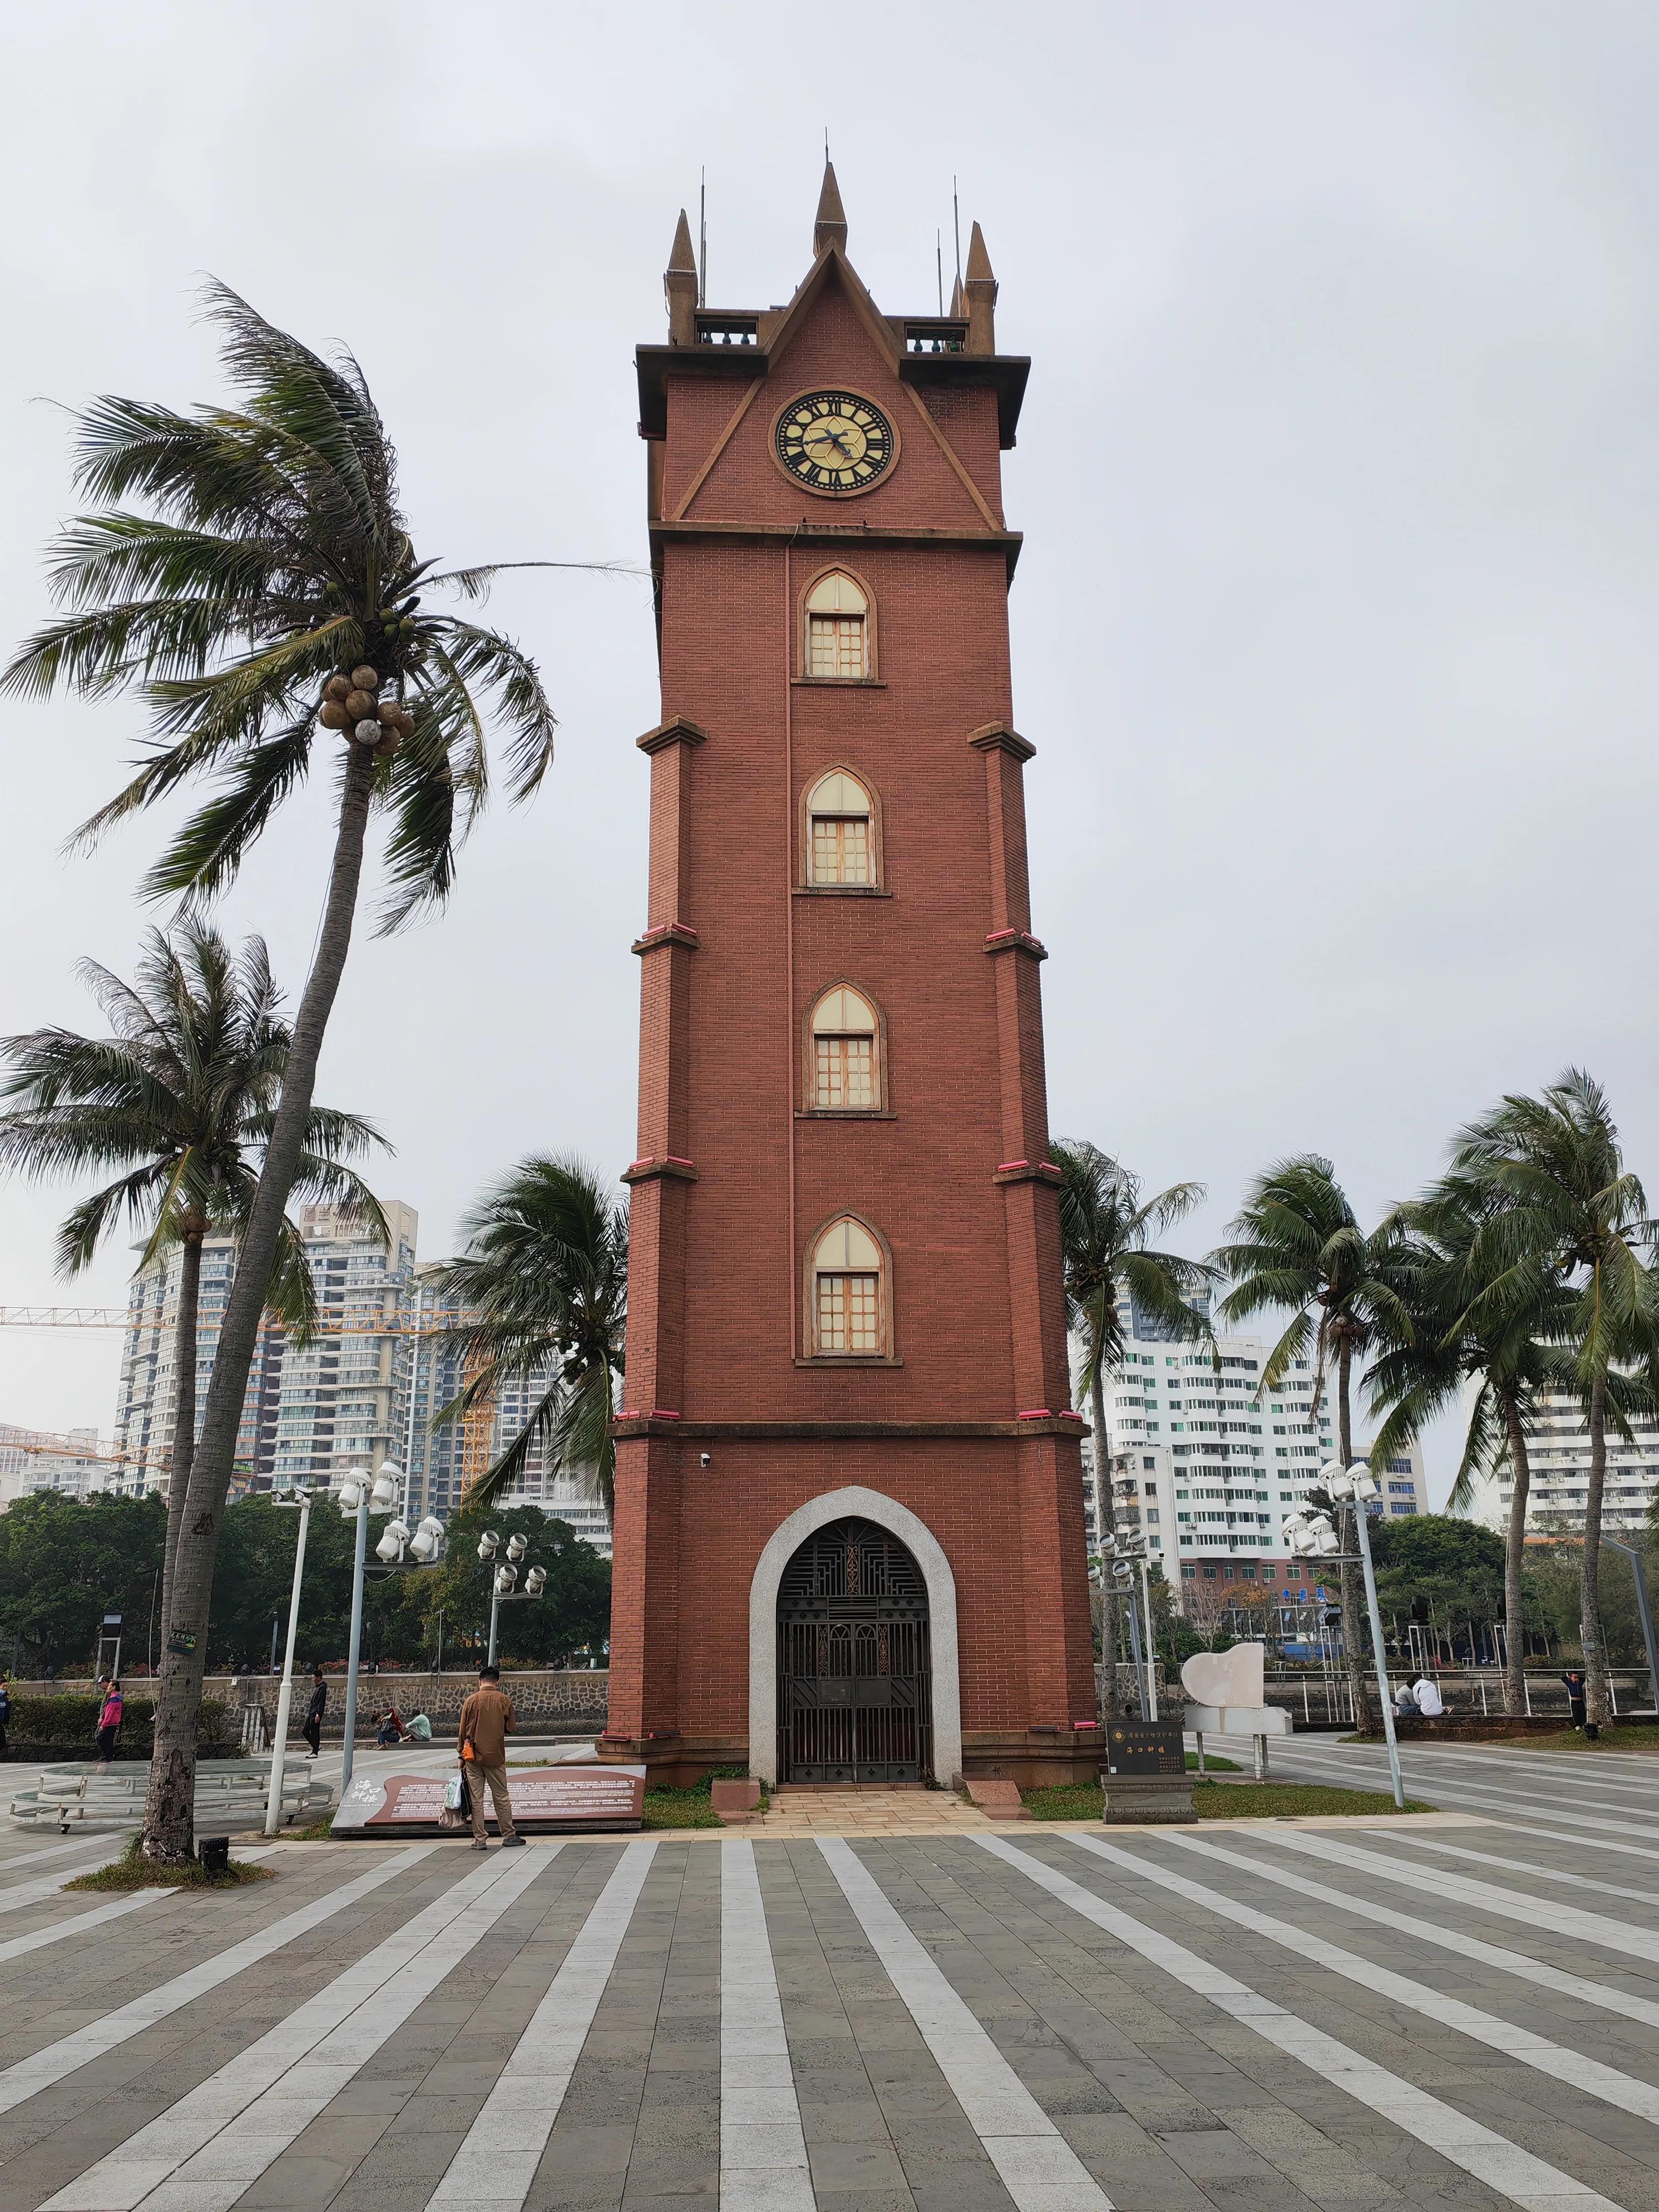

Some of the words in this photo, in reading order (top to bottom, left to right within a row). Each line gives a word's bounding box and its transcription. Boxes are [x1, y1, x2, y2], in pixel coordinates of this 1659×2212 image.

[828, 401, 841, 415] XII
[867, 438, 884, 450] III
[1127, 1745, 1165, 1755] 海口钟楼
